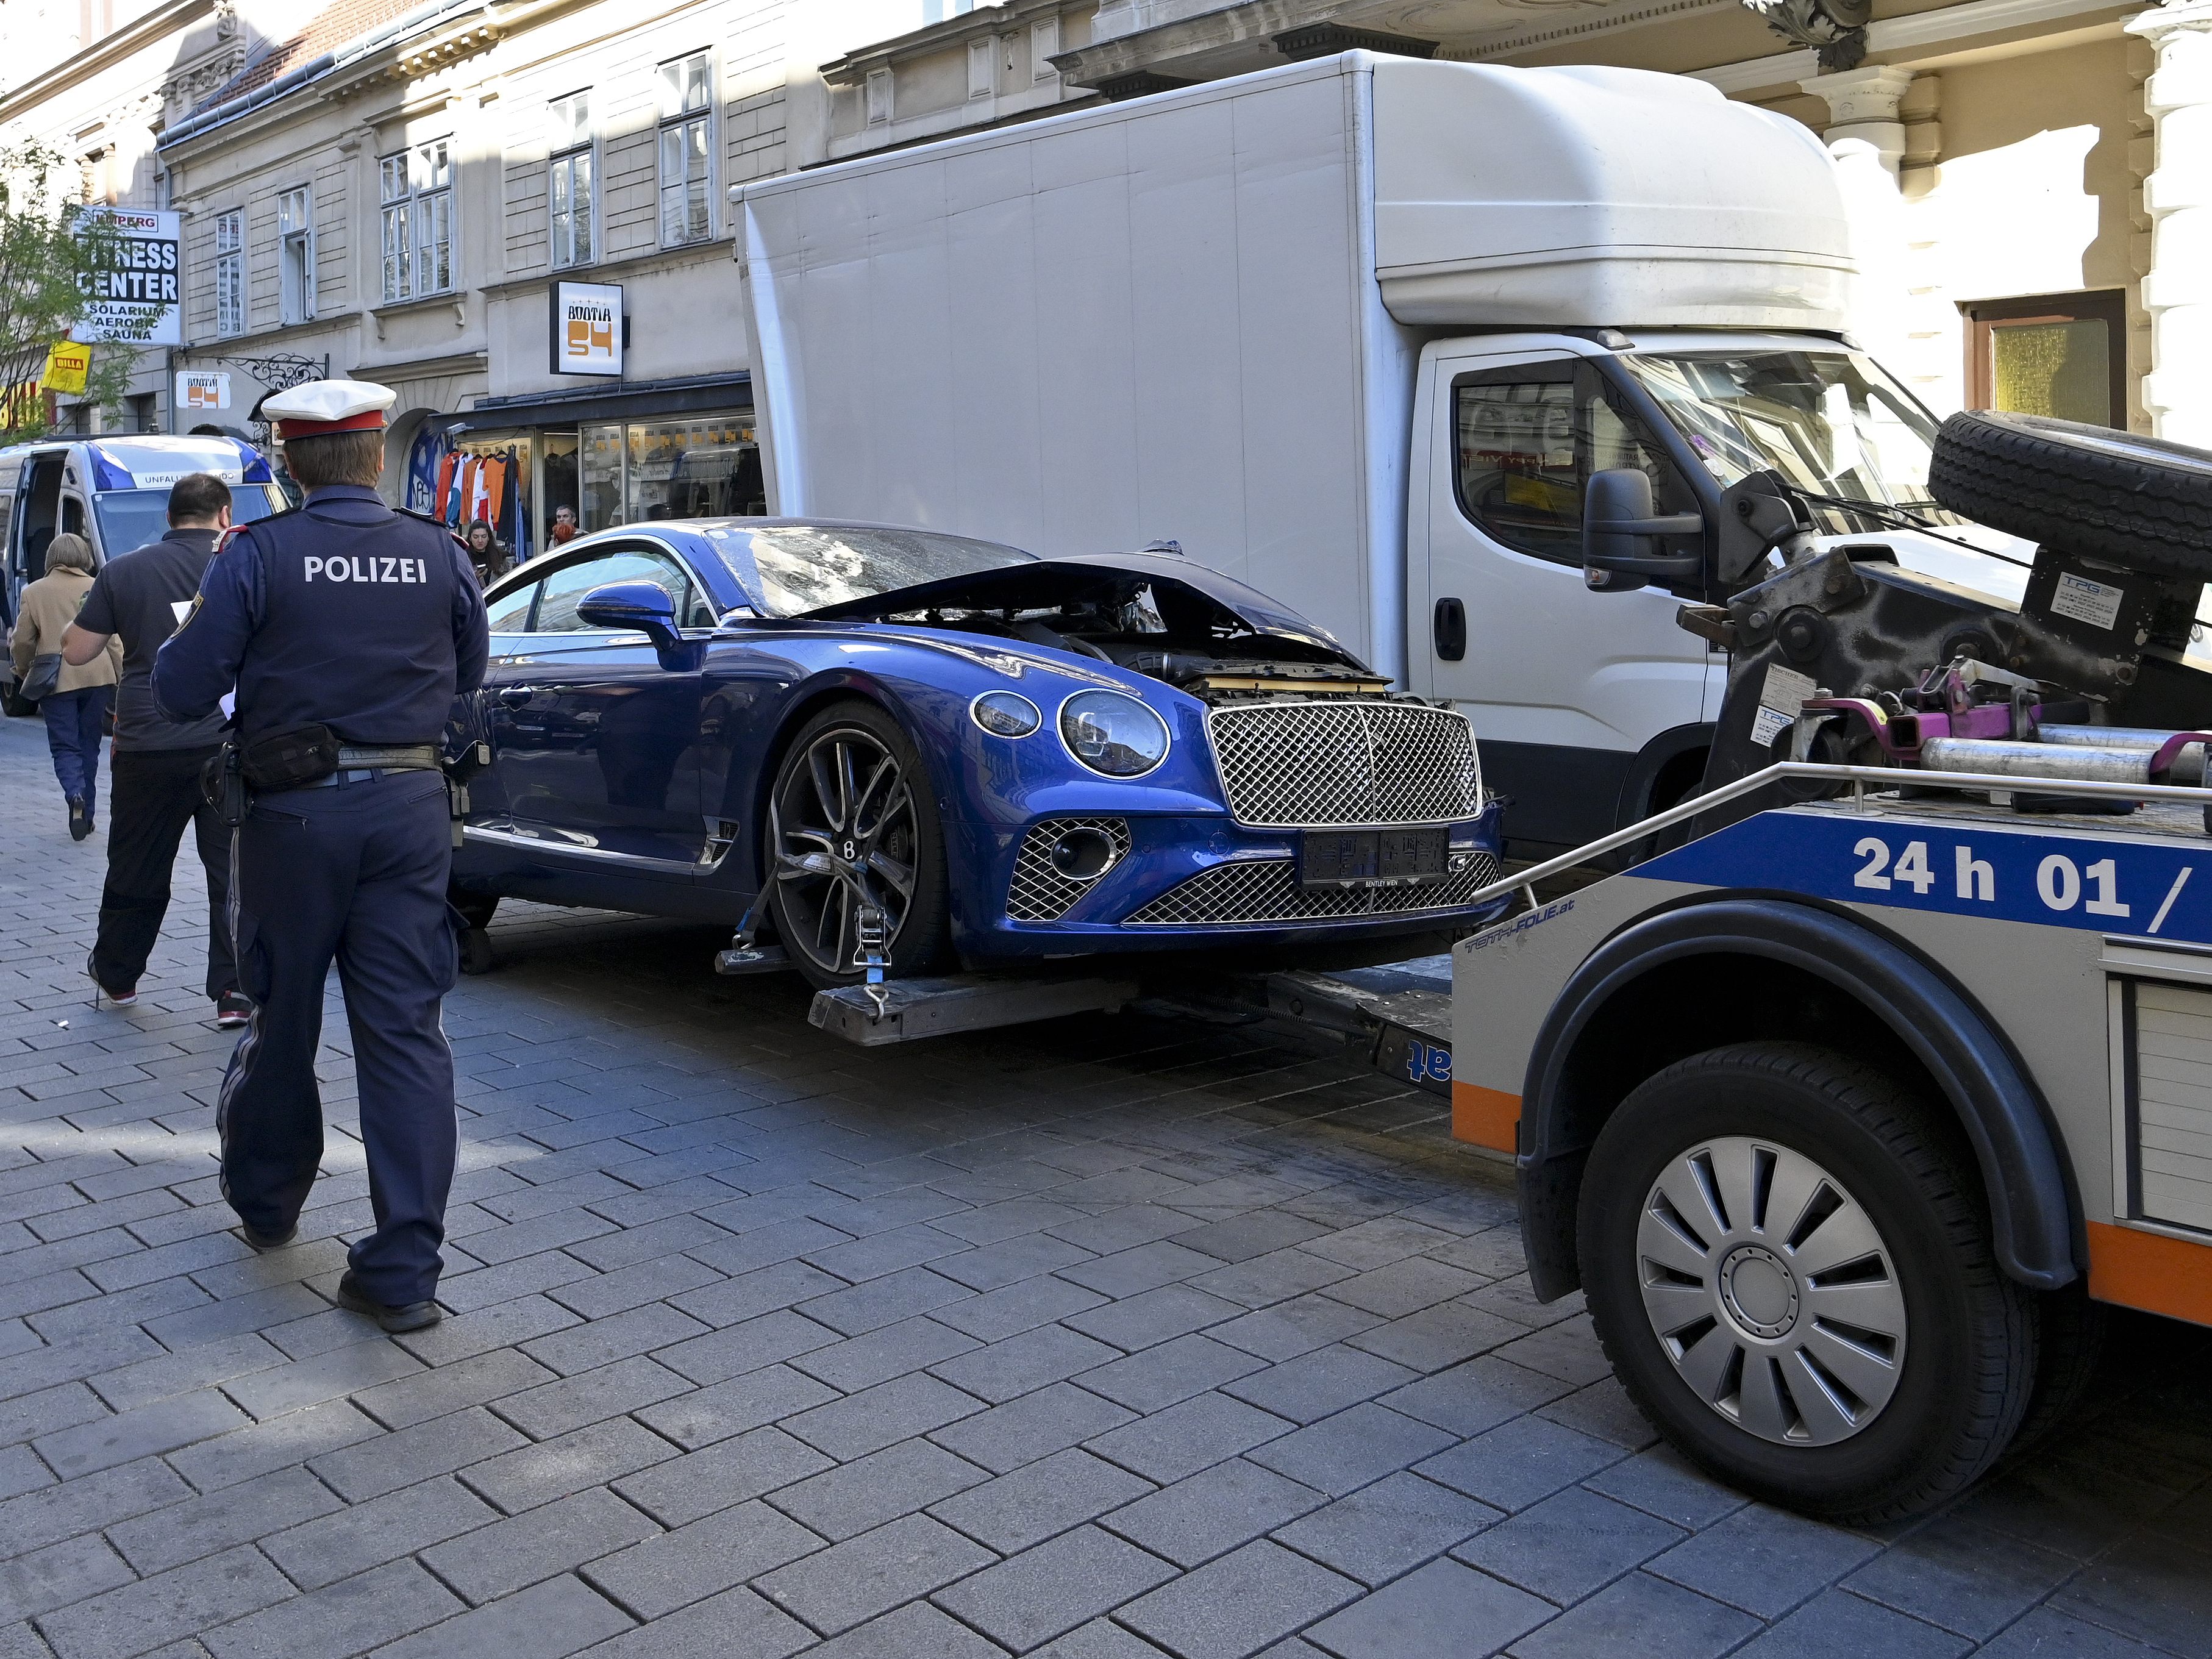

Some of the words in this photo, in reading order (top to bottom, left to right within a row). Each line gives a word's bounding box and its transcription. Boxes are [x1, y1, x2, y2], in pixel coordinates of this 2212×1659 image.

[102, 329, 152, 340] SAUNA
[57, 359, 82, 369] BILLA
[304, 555, 427, 583] POLIZEI
[2064, 575, 2101, 594] TPG
[1853, 837, 1935, 894] 24
[1955, 845, 1995, 901] h
[2036, 854, 2130, 918] 01
[1465, 899, 1575, 954] TOTH-FOLIE.at
[1406, 1039, 1453, 1083] at
